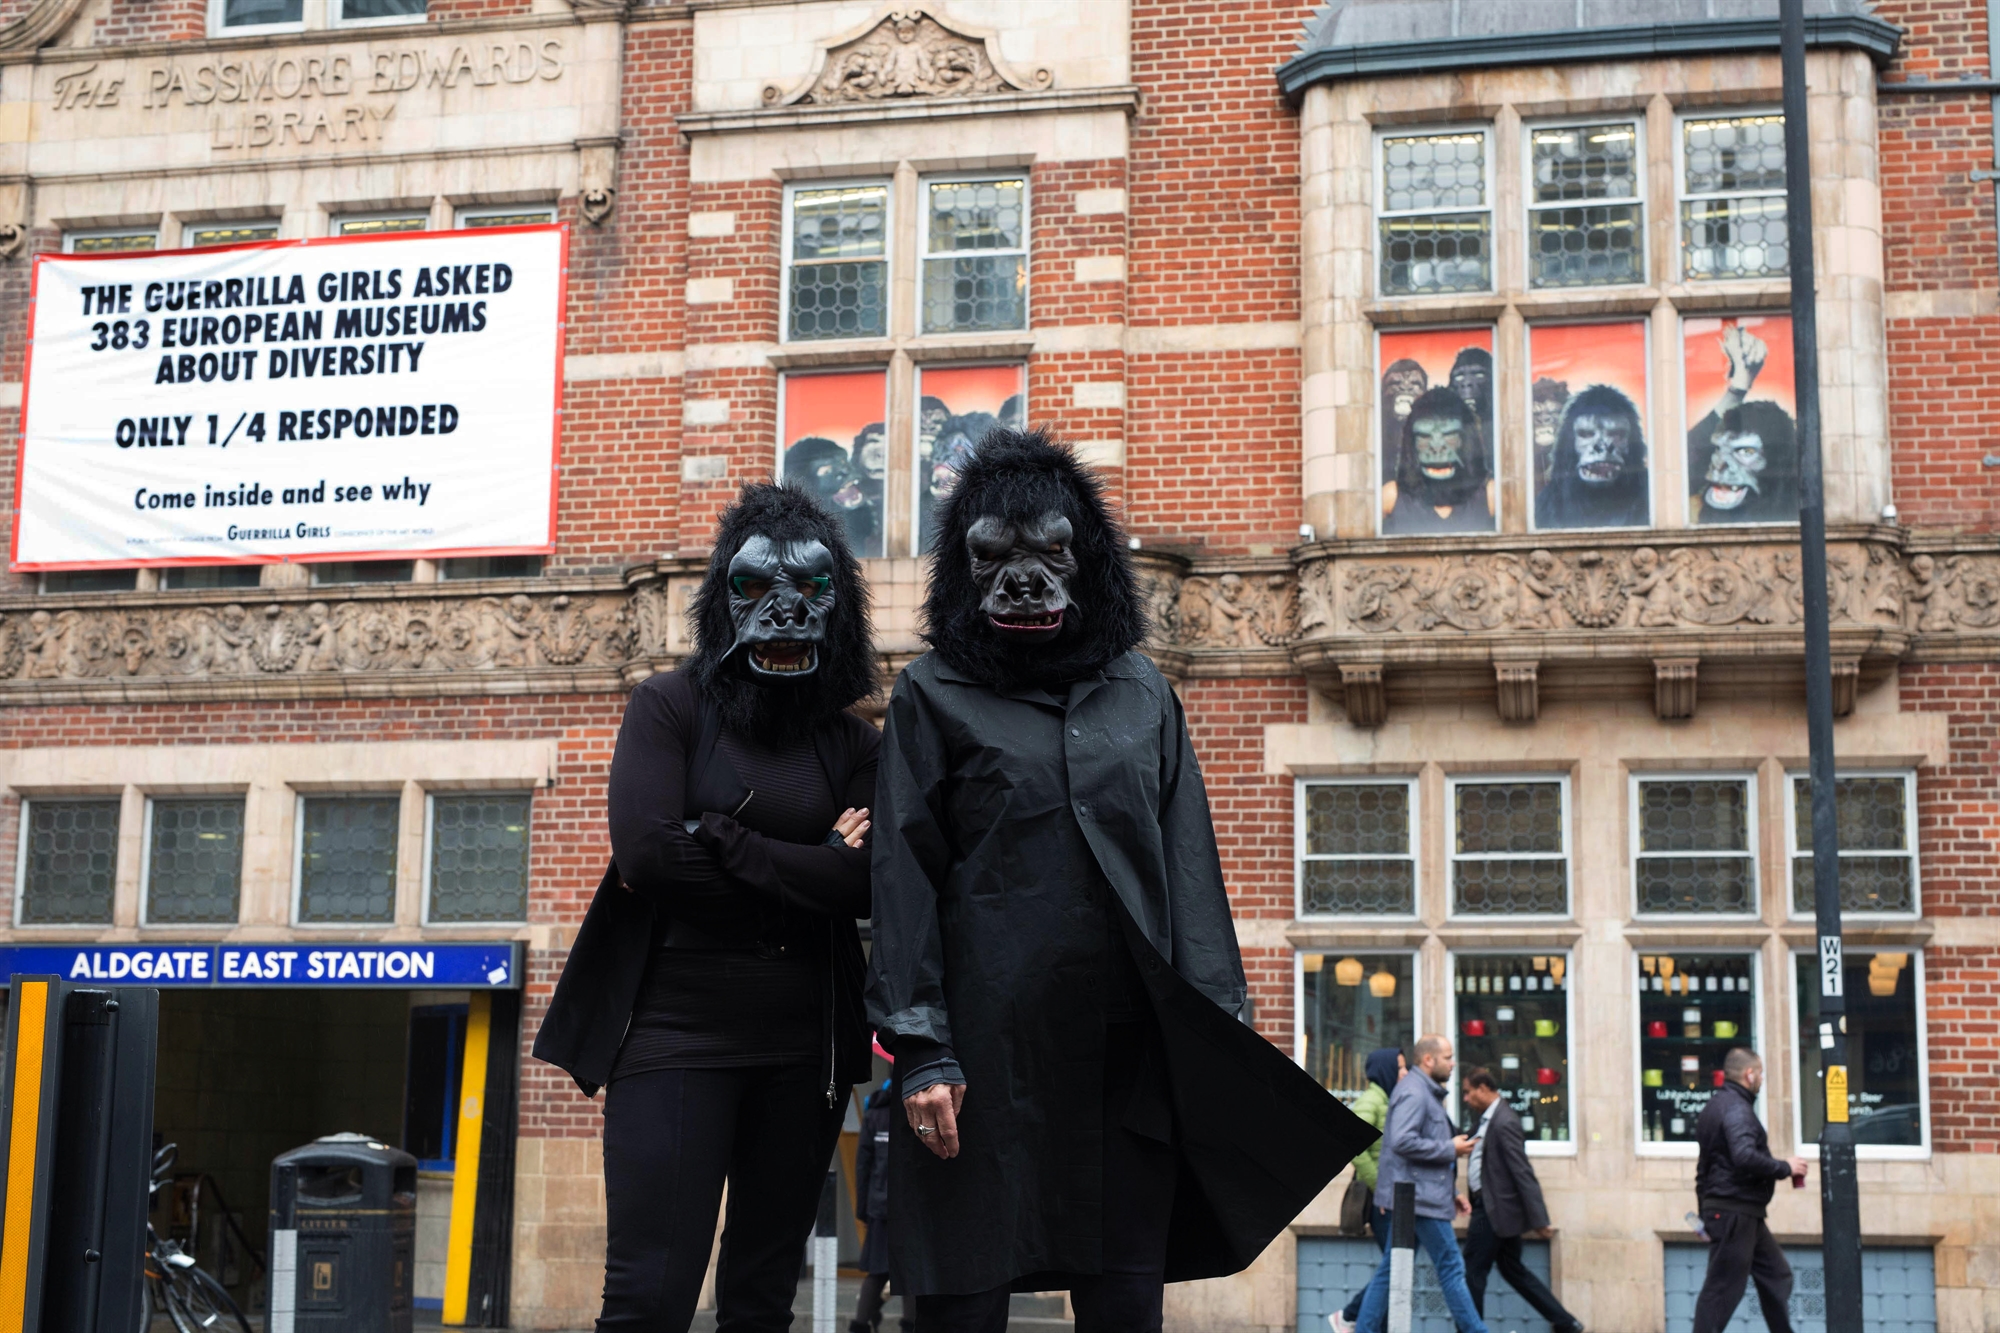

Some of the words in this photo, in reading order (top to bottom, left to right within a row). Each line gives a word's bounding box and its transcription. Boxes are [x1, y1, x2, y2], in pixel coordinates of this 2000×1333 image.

[52, 62, 125, 110] THE
[143, 54, 350, 109] PASSMORE
[367, 38, 565, 94] EDWARDS
[210, 104, 395, 150] LIBRARY
[82, 285, 132, 315] THE
[144, 275, 305, 313] GUERRILLA
[318, 270, 402, 303] GIRLS
[413, 263, 513, 298] ASKED
[91, 319, 150, 351] 383
[161, 310, 323, 348] EUROPEAN
[334, 302, 487, 339] MUSEUMS
[155, 350, 258, 385] ABOUT
[268, 342, 425, 379] DIVERSITY
[115, 415, 192, 449] ONLY
[207, 411, 266, 448] 1/4
[278, 404, 459, 442] RESPONDED
[135, 488, 196, 510] Come
[205, 483, 273, 507] inside
[282, 480, 325, 505] and
[334, 485, 373, 502] see
[382, 476, 431, 506] why
[70, 951, 209, 979] ALDGATE
[223, 951, 298, 979] EAST
[307, 951, 435, 979] STATION
